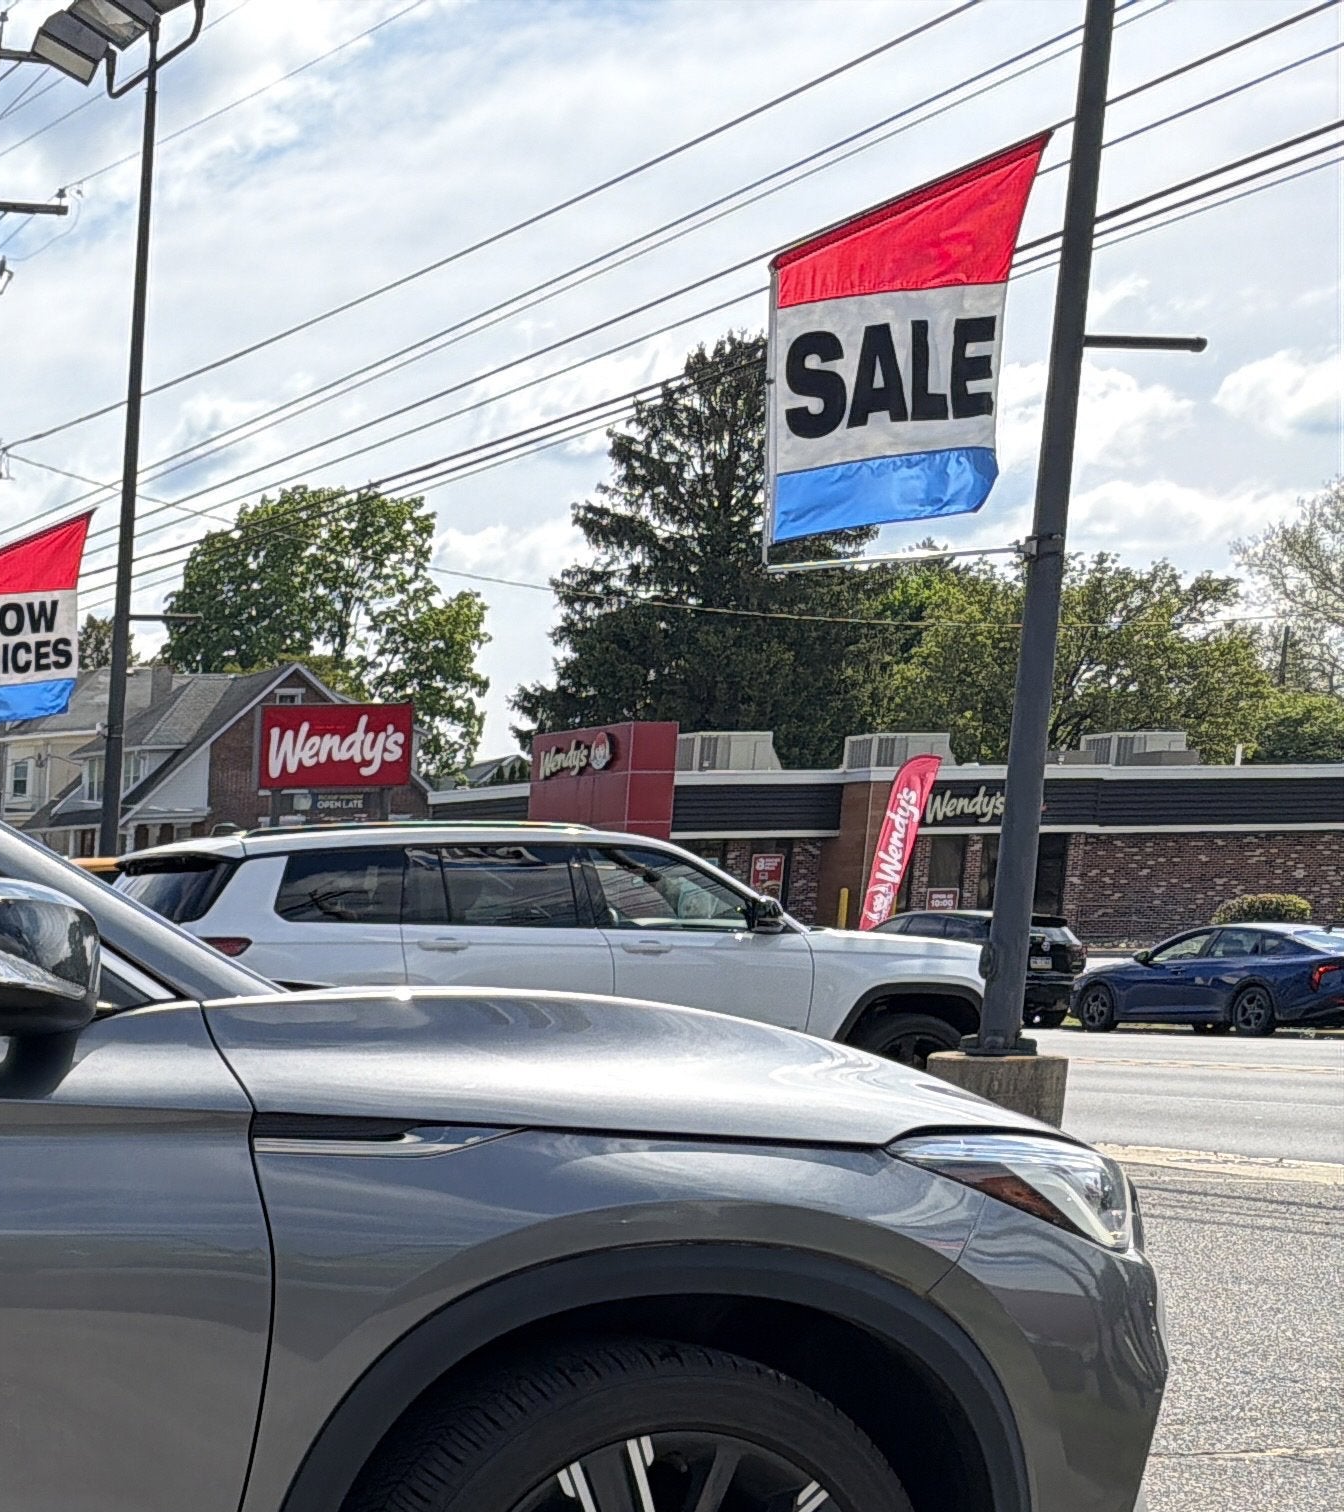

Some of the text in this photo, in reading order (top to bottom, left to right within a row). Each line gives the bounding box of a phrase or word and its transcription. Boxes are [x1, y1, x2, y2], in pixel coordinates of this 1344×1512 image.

[785, 315, 997, 440] SALE
[268, 714, 405, 779] Wendy's
[539, 739, 589, 780] Wendy's
[316, 799, 363, 809] OPEN LATE
[925, 785, 1006, 824] Wendy's
[874, 787, 921, 884] Wendy's
